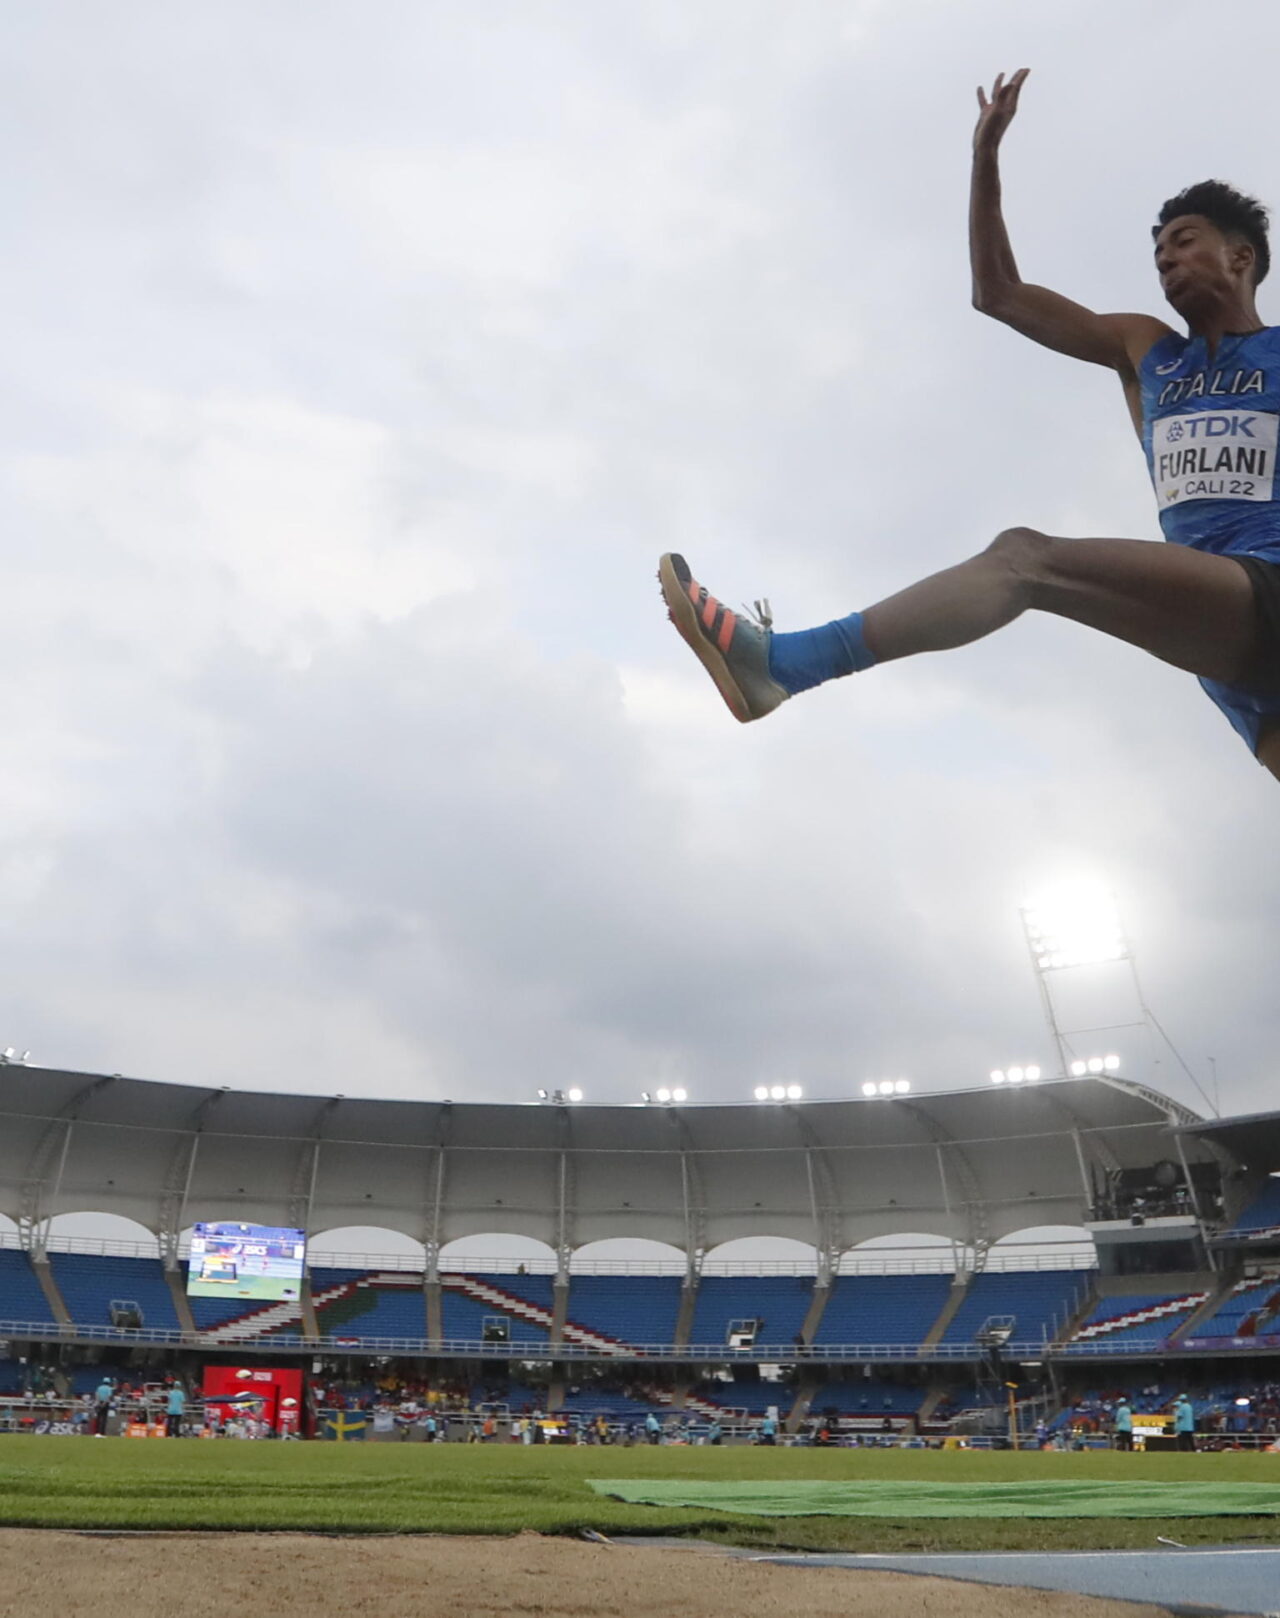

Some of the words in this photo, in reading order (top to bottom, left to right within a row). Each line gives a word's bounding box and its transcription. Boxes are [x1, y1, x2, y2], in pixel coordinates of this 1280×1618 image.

[1158, 369, 1264, 407] ITALIA
[1185, 416, 1257, 438] TDK
[1160, 446, 1267, 482] FURLANI
[1185, 480, 1224, 495] CALI
[1229, 480, 1255, 496] 22
